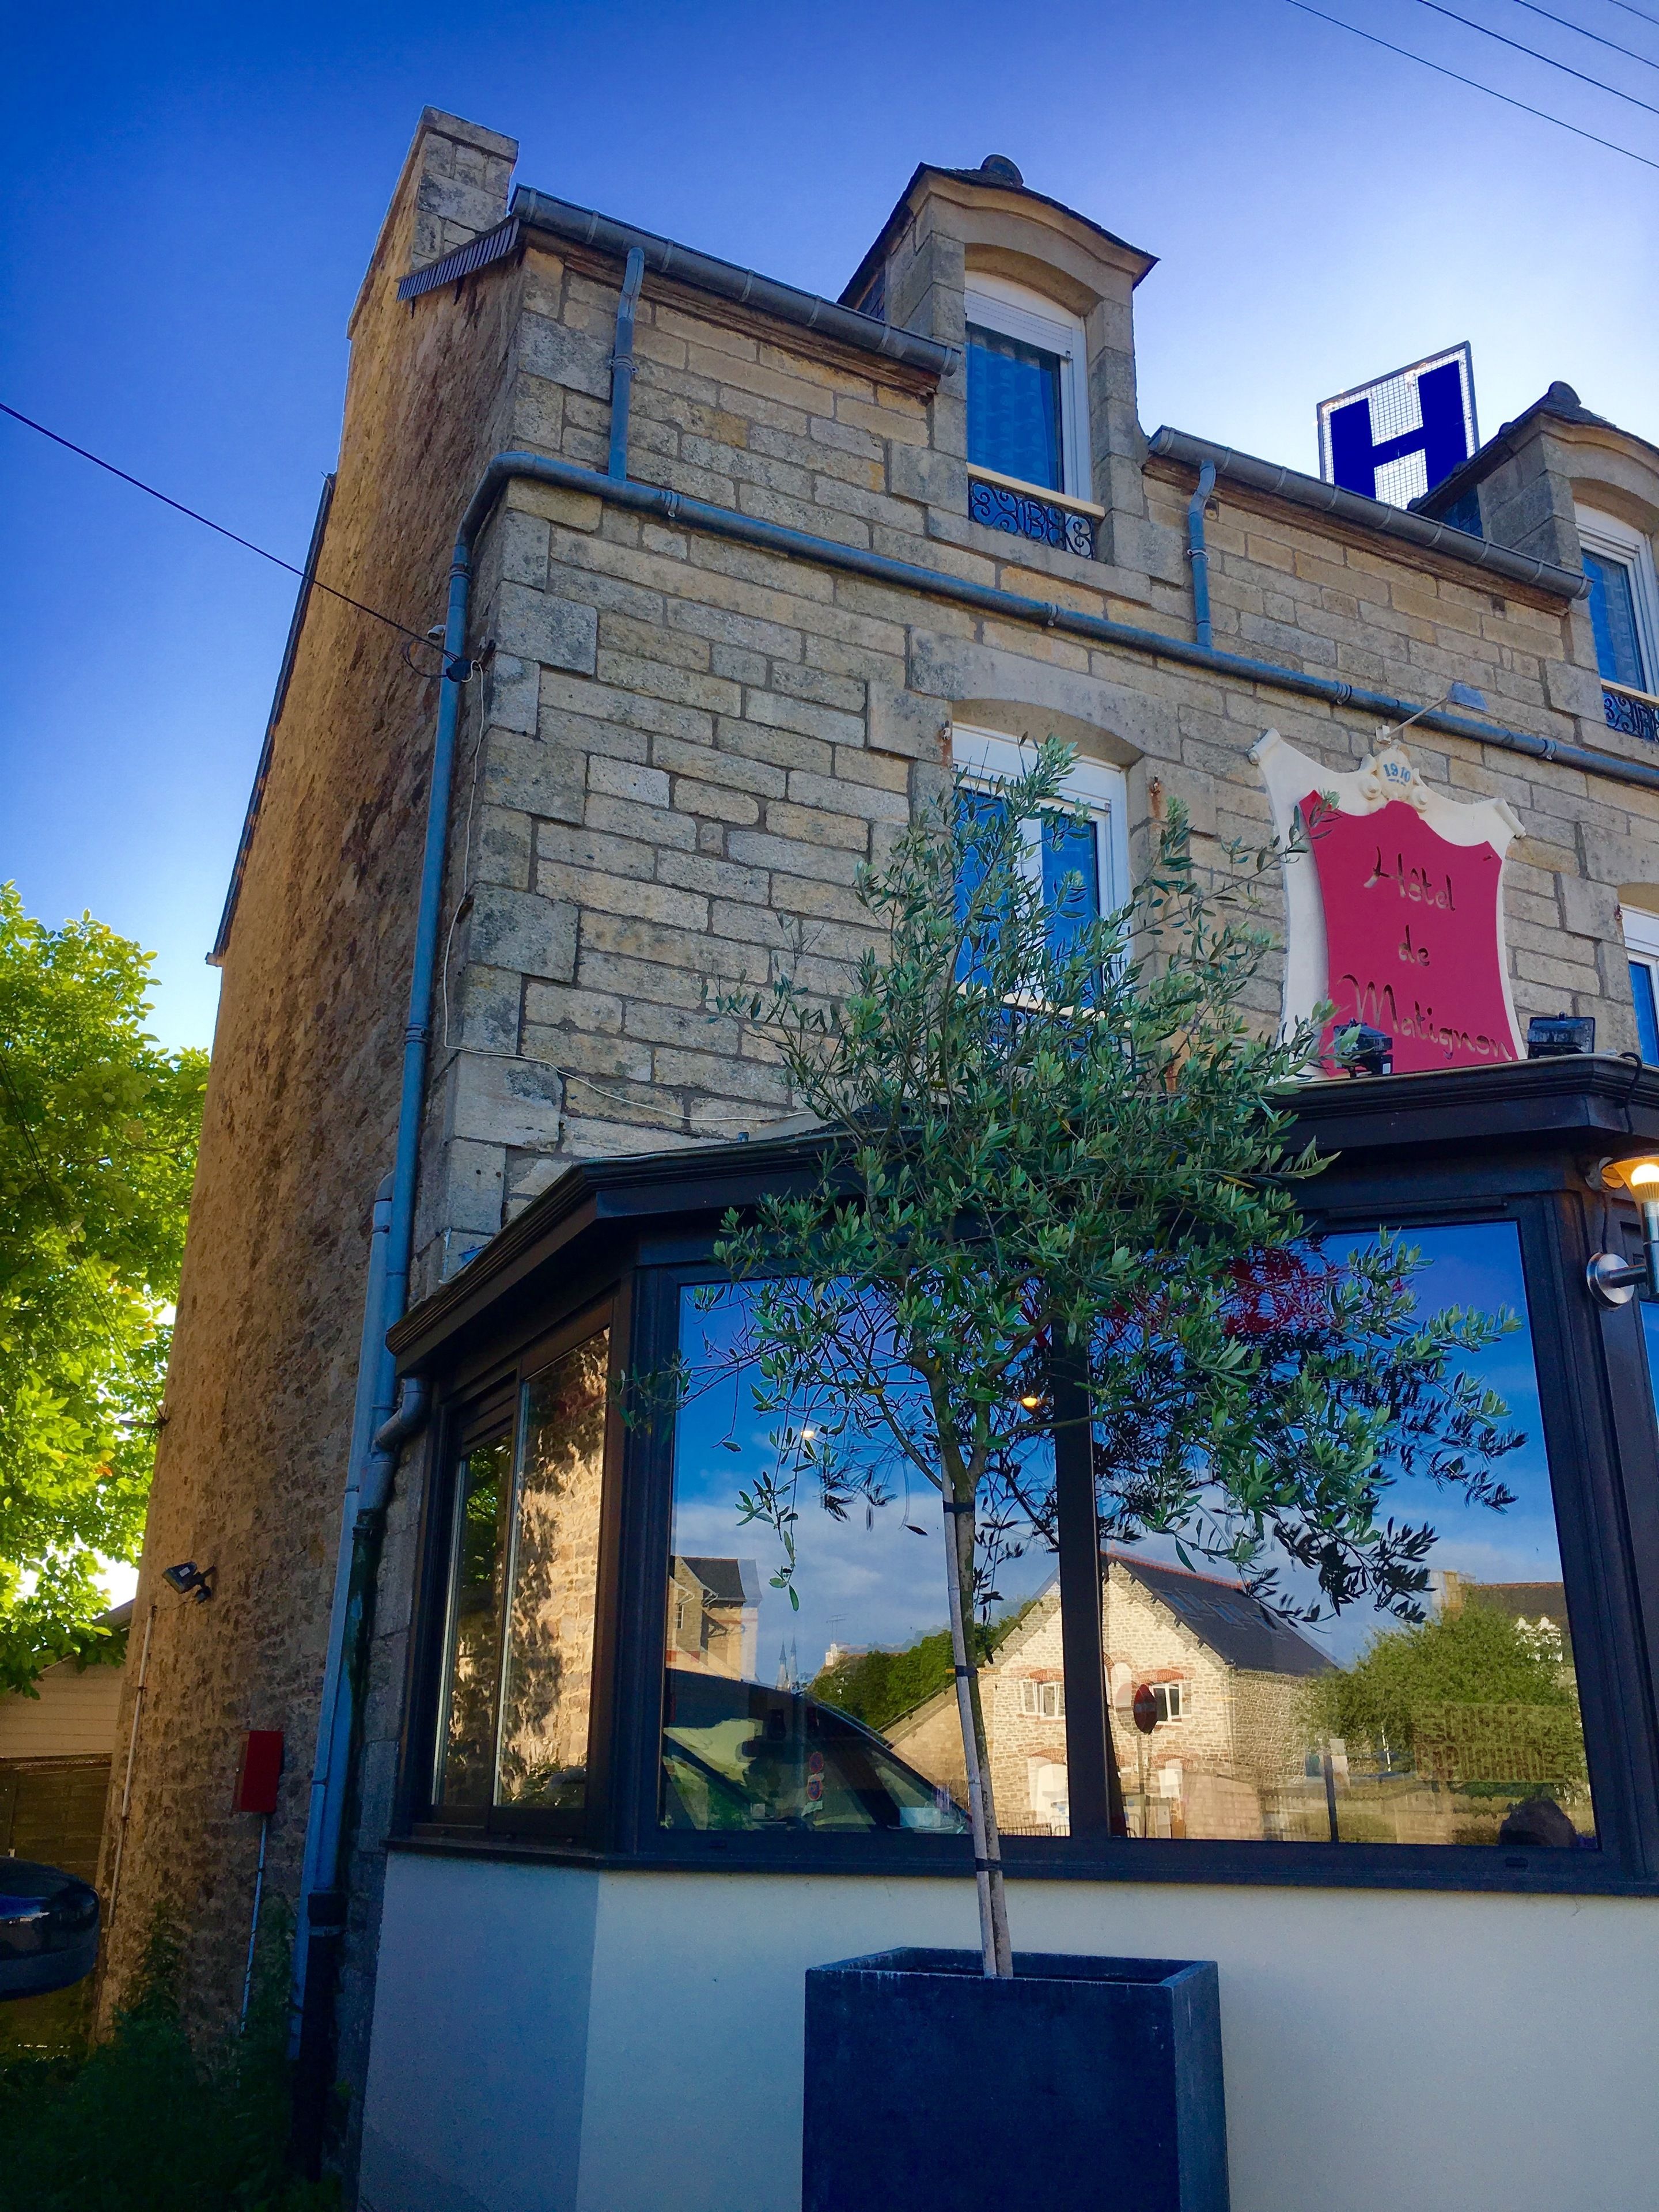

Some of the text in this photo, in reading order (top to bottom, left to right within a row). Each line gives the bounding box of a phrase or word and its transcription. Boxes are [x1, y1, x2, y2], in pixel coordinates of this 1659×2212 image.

[1330, 359, 1469, 499] H
[1384, 763, 1411, 783] 1910
[1363, 846, 1456, 911] Hôtel
[1399, 924, 1430, 967] de
[1336, 974, 1513, 1061] Matignon
